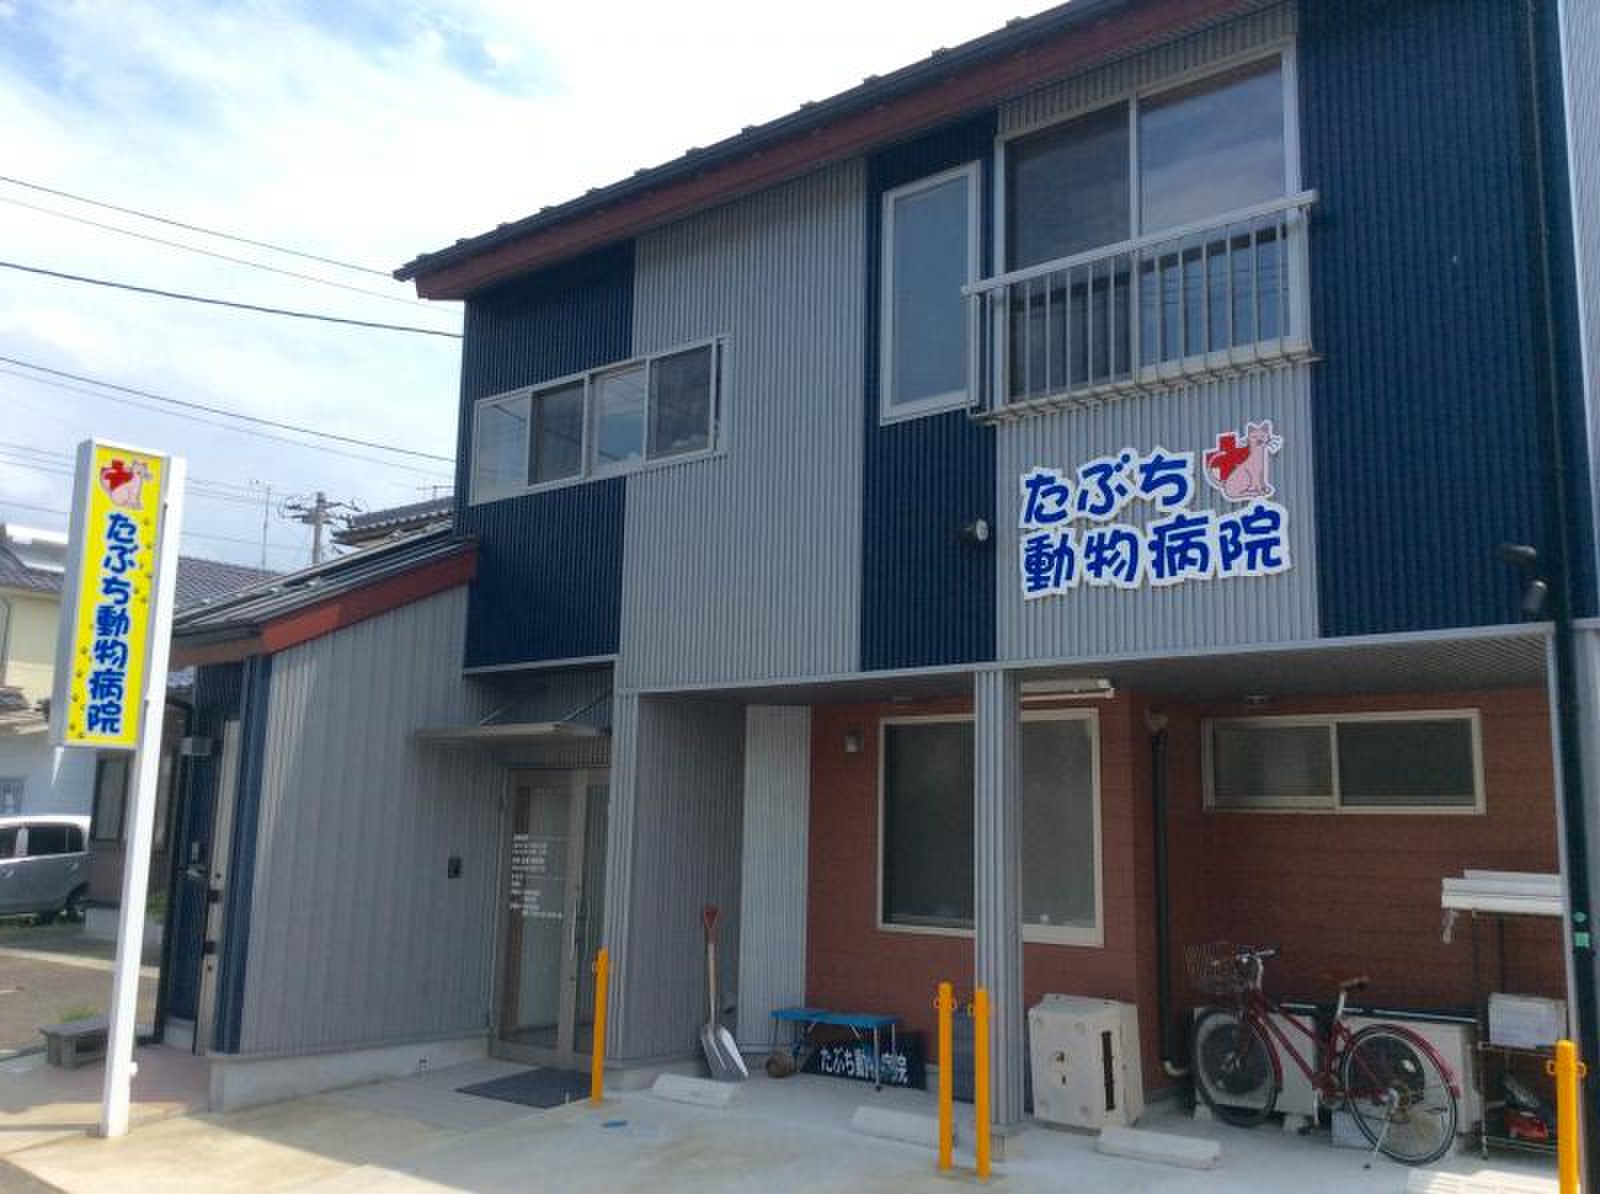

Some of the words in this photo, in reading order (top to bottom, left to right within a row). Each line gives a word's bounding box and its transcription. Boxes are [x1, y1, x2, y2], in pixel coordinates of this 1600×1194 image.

[1023, 452, 1188, 524] たぶち
[1023, 504, 1282, 593] 動物病院
[87, 512, 138, 734] たぶち動物病院
